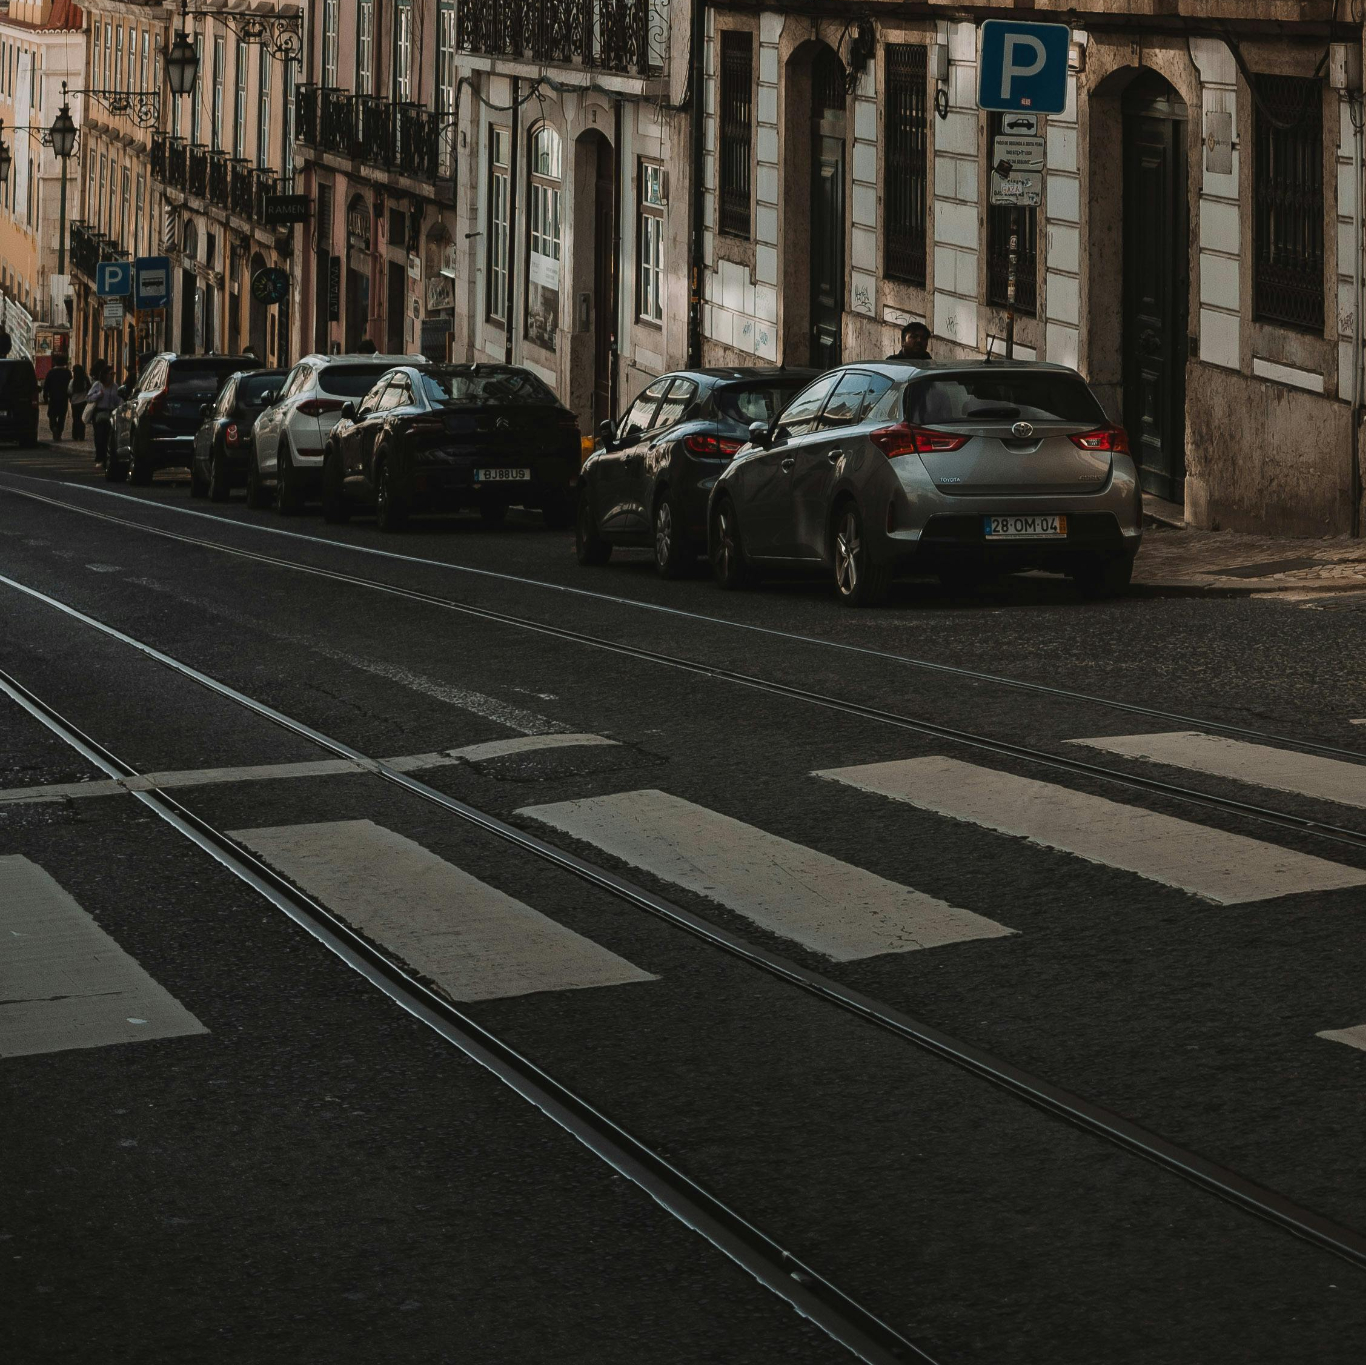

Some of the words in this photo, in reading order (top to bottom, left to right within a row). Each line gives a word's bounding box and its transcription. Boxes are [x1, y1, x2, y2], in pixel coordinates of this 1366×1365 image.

[1000, 32, 1047, 100] P
[268, 204, 305, 214] RAMEN
[104, 266, 123, 292] P
